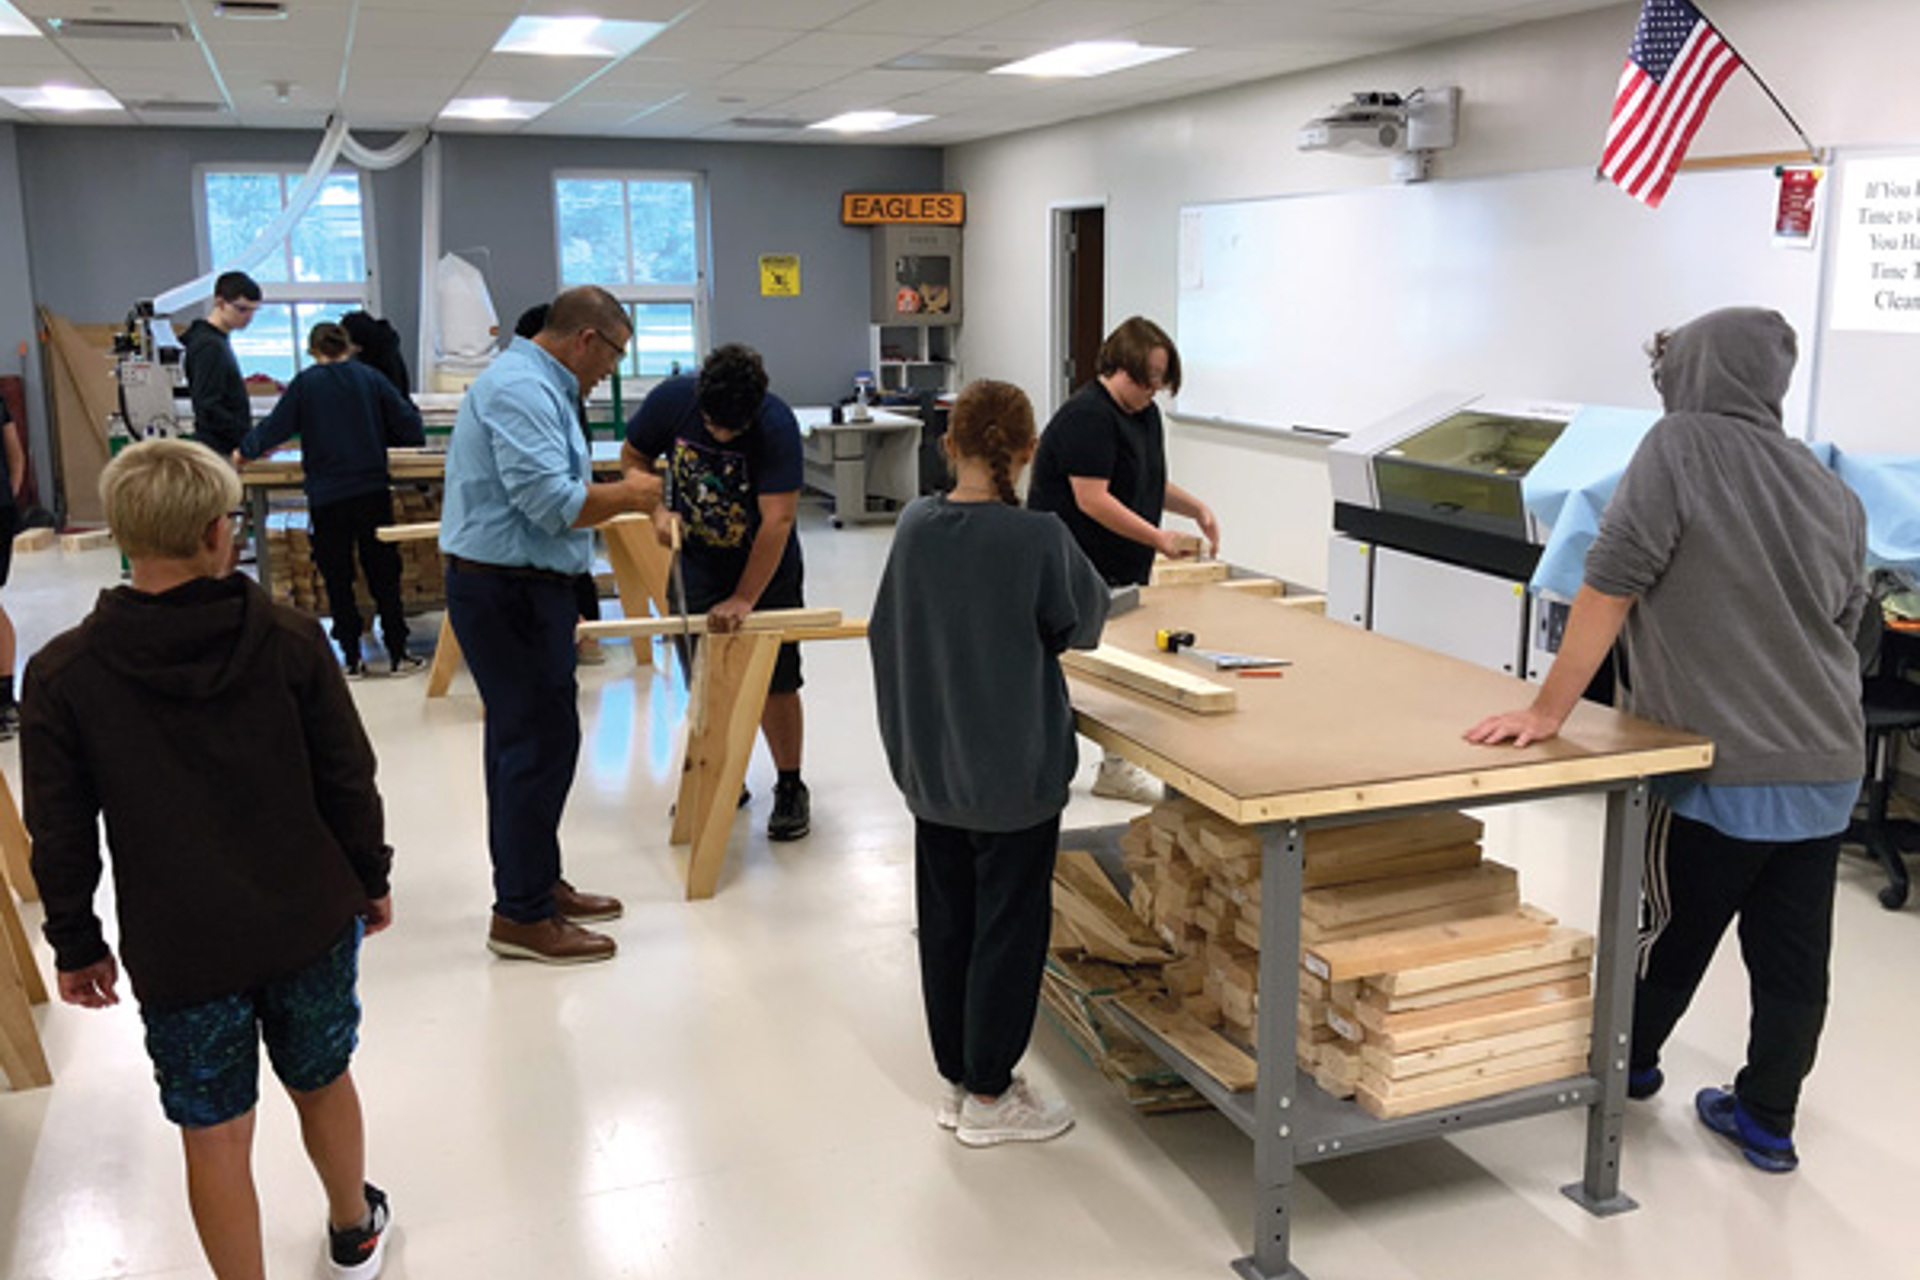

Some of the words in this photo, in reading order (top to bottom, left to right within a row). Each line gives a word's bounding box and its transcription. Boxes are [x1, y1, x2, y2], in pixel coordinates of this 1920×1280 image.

[1879, 180, 1911, 199] You
[851, 197, 954, 219] EAGLES
[1857, 207, 1895, 225] Time
[1869, 232, 1899, 251] You
[1870, 262, 1908, 280] Time
